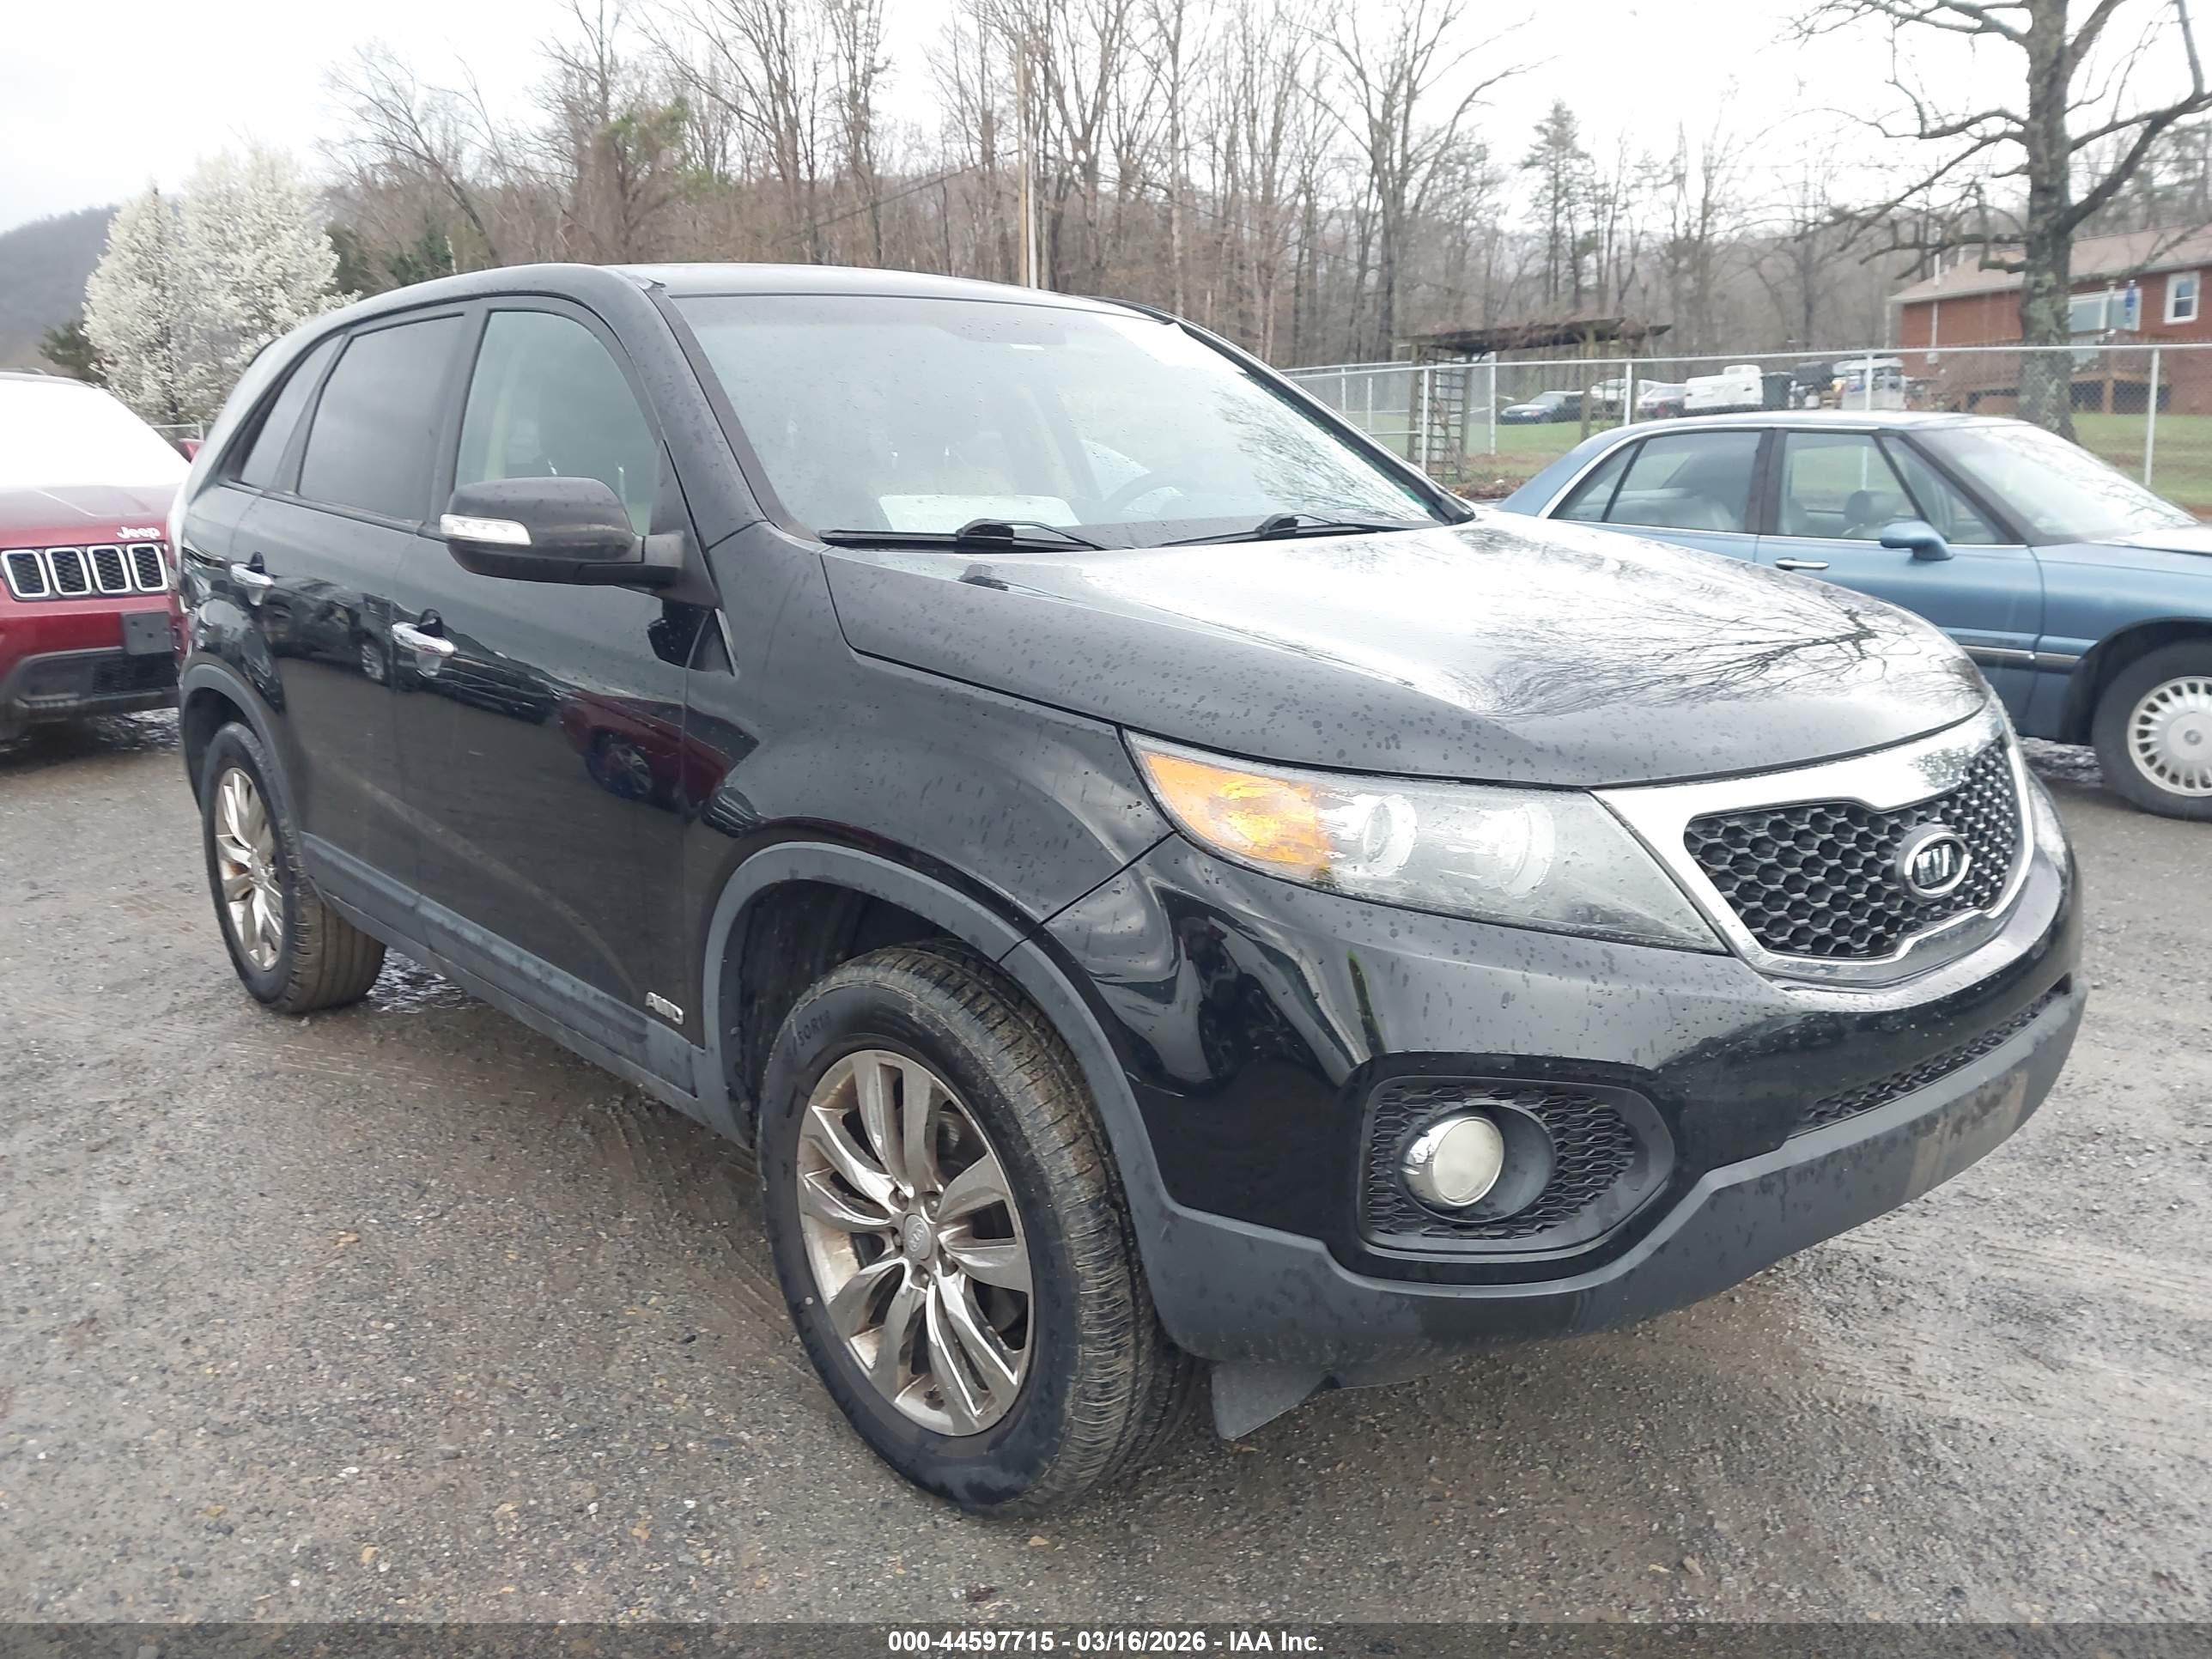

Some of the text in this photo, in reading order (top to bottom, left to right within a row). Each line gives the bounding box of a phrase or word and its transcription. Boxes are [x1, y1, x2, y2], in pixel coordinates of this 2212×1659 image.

[116, 526, 161, 539] Jeep
[1915, 843, 1959, 887] KIA
[645, 991, 684, 1025] AWD
